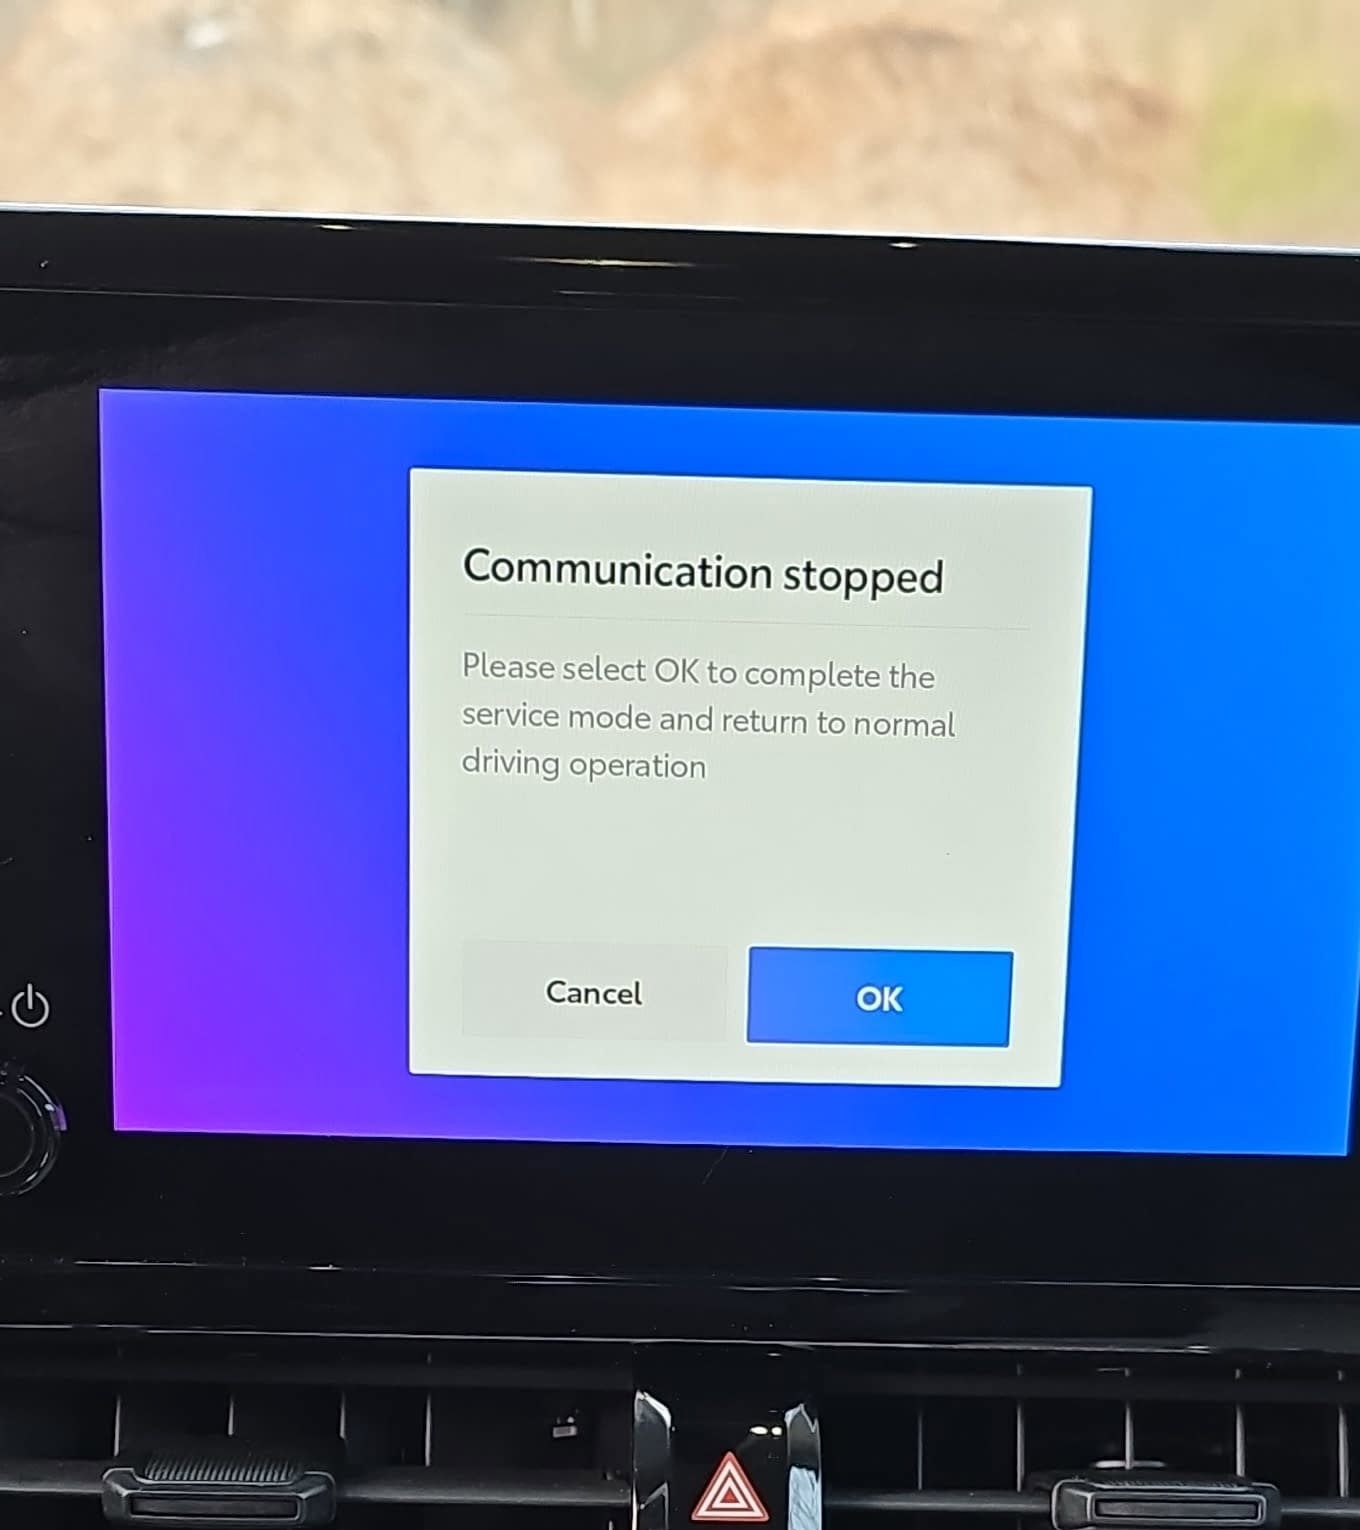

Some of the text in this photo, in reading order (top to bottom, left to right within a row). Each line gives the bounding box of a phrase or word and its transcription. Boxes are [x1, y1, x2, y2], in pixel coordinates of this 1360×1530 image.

[462, 547, 944, 600] Communication stopped
[462, 651, 936, 692] Please select OK to complete the
[462, 701, 956, 738] service mode and return to normal
[461, 749, 707, 782] driving operation
[546, 979, 643, 1007] Cancel
[856, 985, 905, 1012] OK
